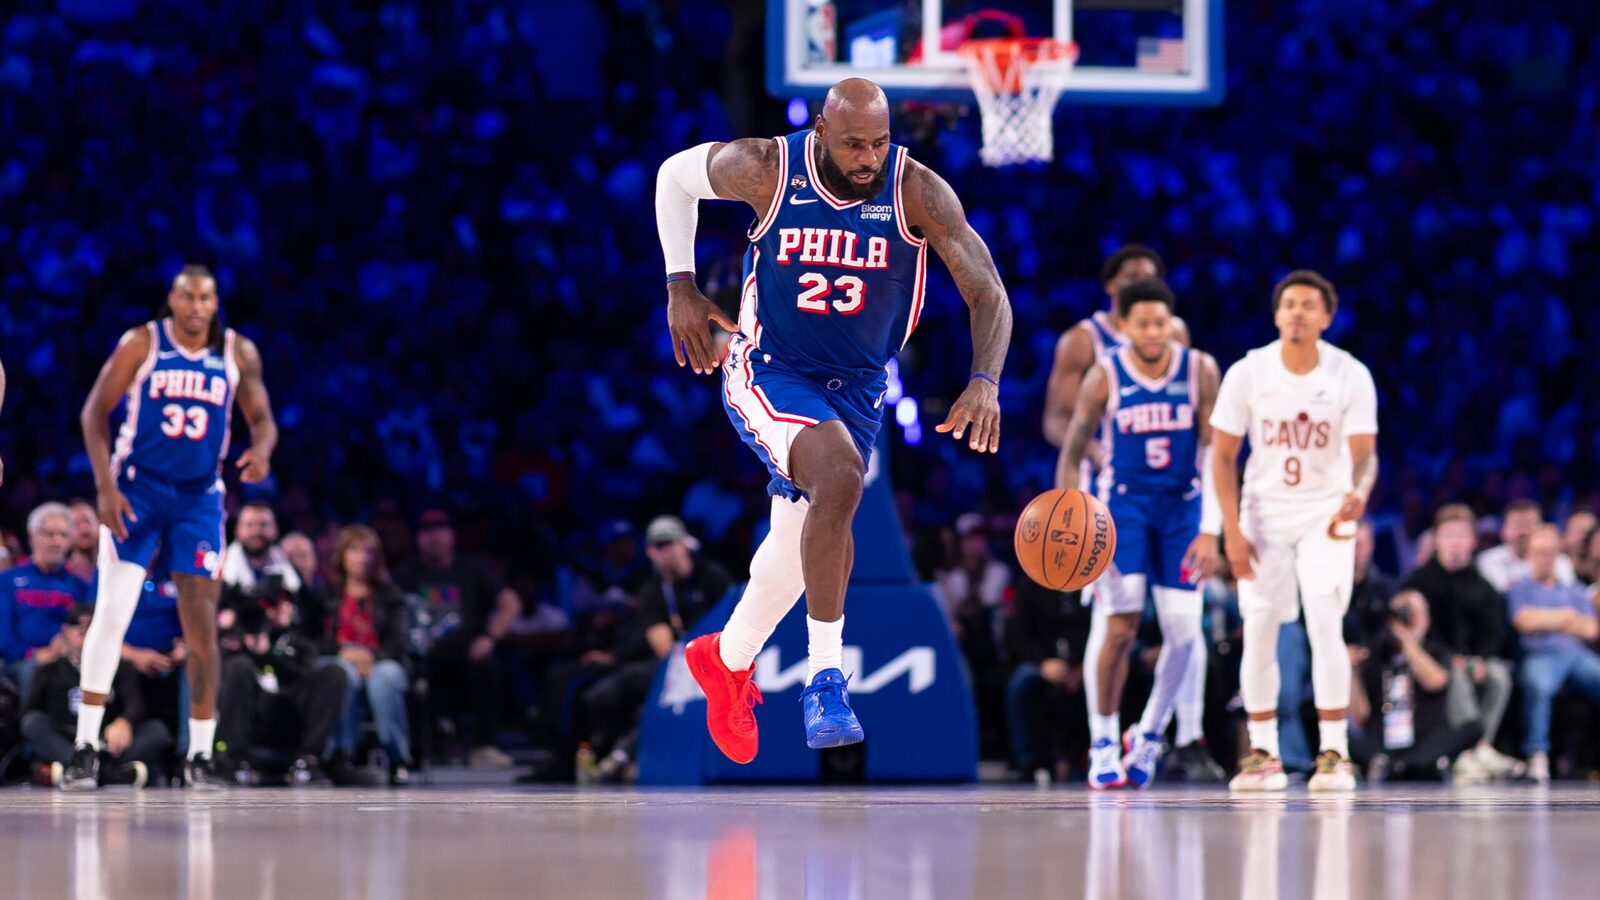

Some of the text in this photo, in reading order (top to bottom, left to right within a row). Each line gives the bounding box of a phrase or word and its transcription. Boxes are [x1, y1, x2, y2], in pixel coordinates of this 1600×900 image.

[860, 212, 892, 221] energy
[861, 204, 892, 213] Bloom
[777, 228, 889, 269] PHILA
[797, 272, 867, 315] 23
[149, 370, 227, 405] PHILA
[161, 403, 208, 440] 33
[1115, 402, 1193, 434] PHILA
[1262, 416, 1331, 450] CAVS
[1144, 437, 1171, 469] 5
[1284, 456, 1302, 486] 9
